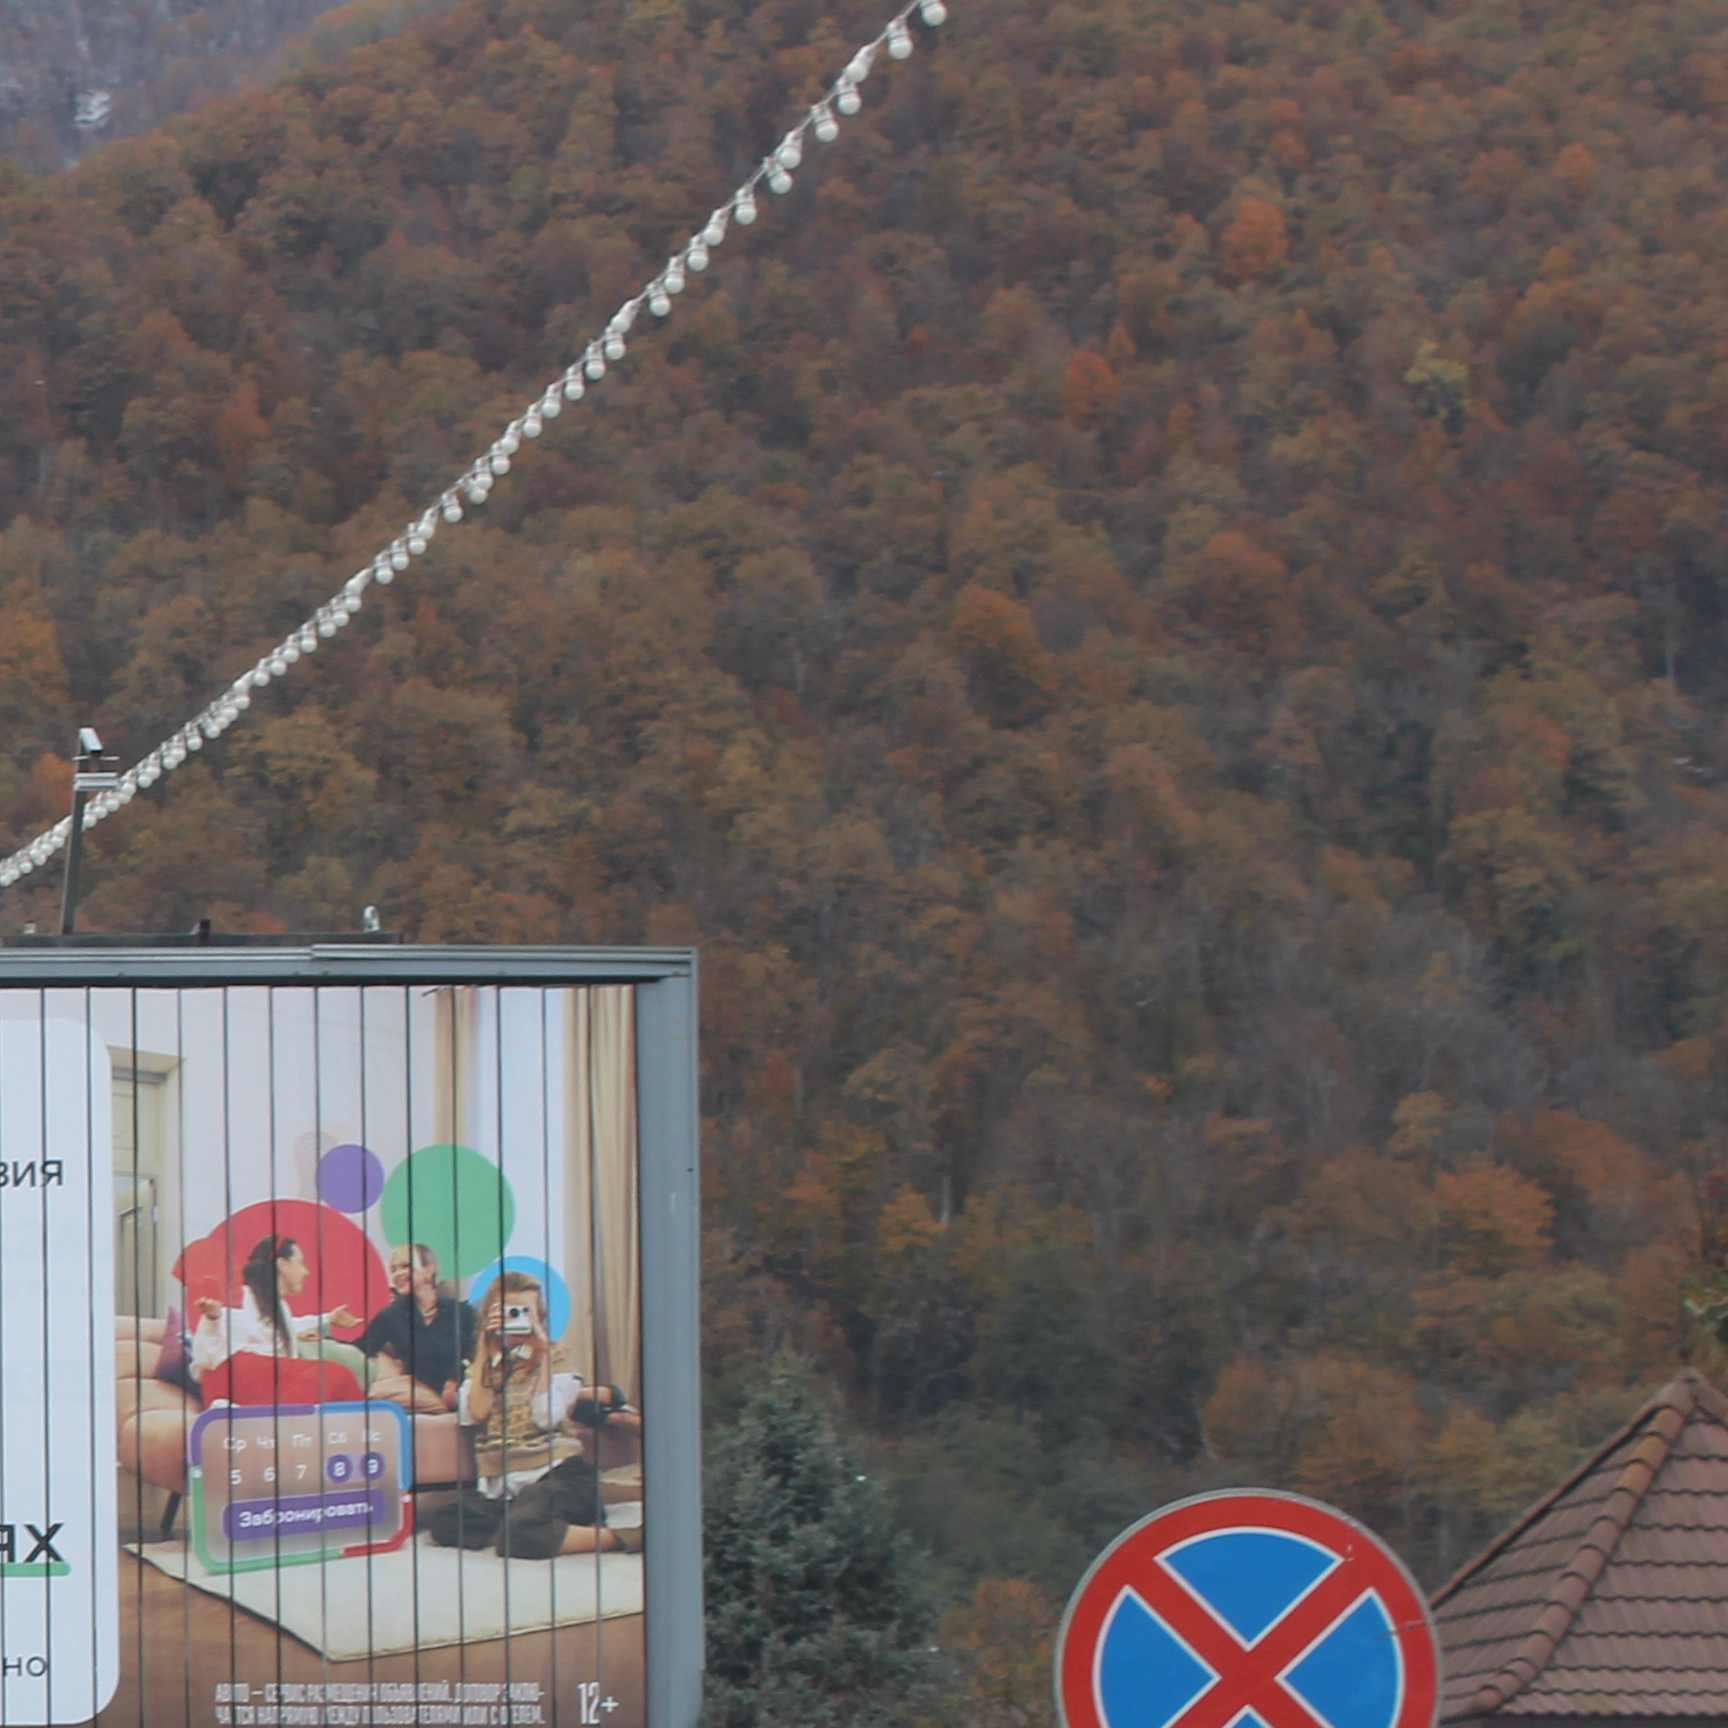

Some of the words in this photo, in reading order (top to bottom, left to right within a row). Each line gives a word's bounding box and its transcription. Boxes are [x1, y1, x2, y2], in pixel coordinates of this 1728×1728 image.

[230, 1469, 242, 1485] 5
[263, 1466, 276, 1482] 6
[295, 1464, 308, 1480] 7
[333, 1461, 347, 1477] 8
[367, 1458, 380, 1474] 9
[577, 1681, 619, 1725] 12+
